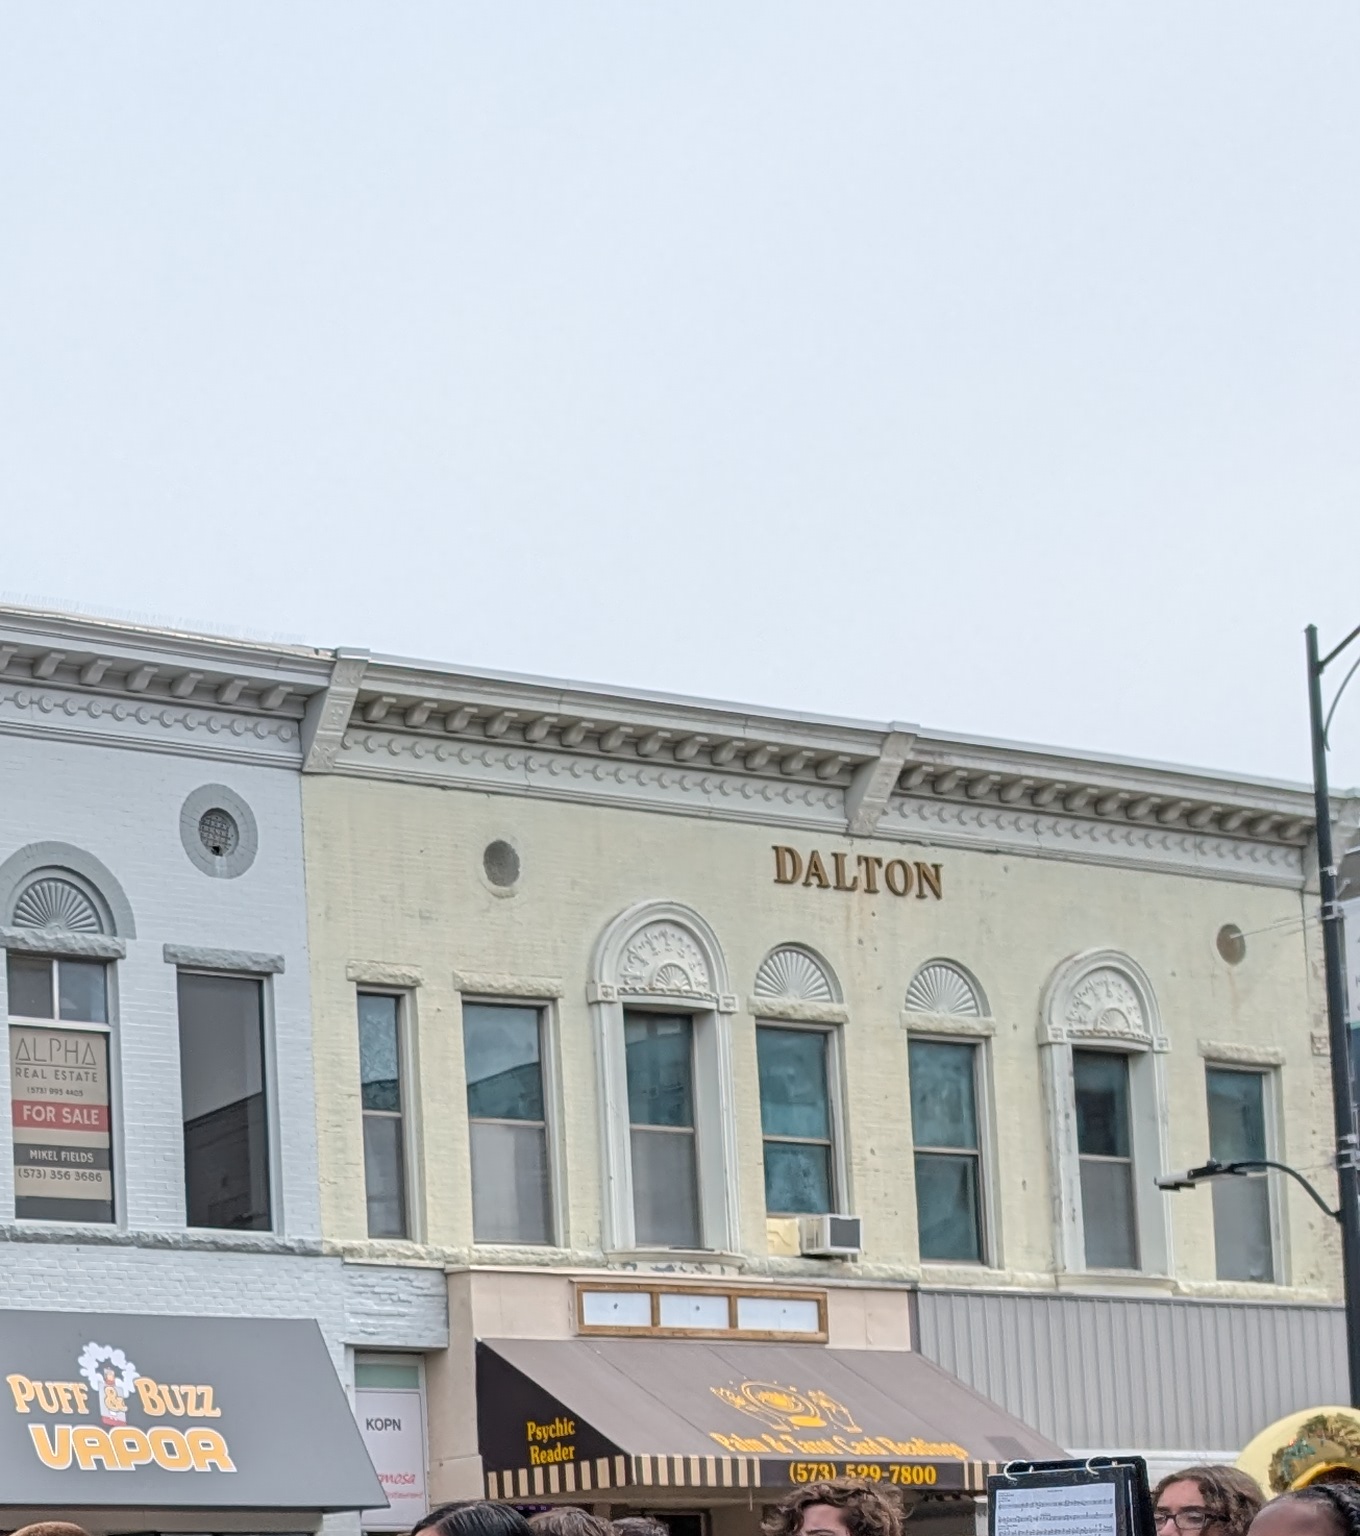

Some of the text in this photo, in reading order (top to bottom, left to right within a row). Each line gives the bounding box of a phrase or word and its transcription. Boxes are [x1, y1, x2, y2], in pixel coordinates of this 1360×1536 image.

[772, 845, 943, 900] DALTON
[15, 1037, 97, 1065] ALPHA
[15, 1068, 98, 1083] REAL ESTATE
[22, 1105, 100, 1125] FOR SALE
[30, 1150, 94, 1164] MIKEL FIELDS
[18, 1168, 46, 1180] (573)
[50, 1169, 71, 1181] 356
[103, 1385, 128, 1413] &
[366, 1418, 402, 1432] KOPN
[526, 1417, 576, 1444] Psychic
[28, 1424, 237, 1473] VAPOR
[530, 1441, 576, 1466] Reader
[789, 1462, 837, 1485] (573)
